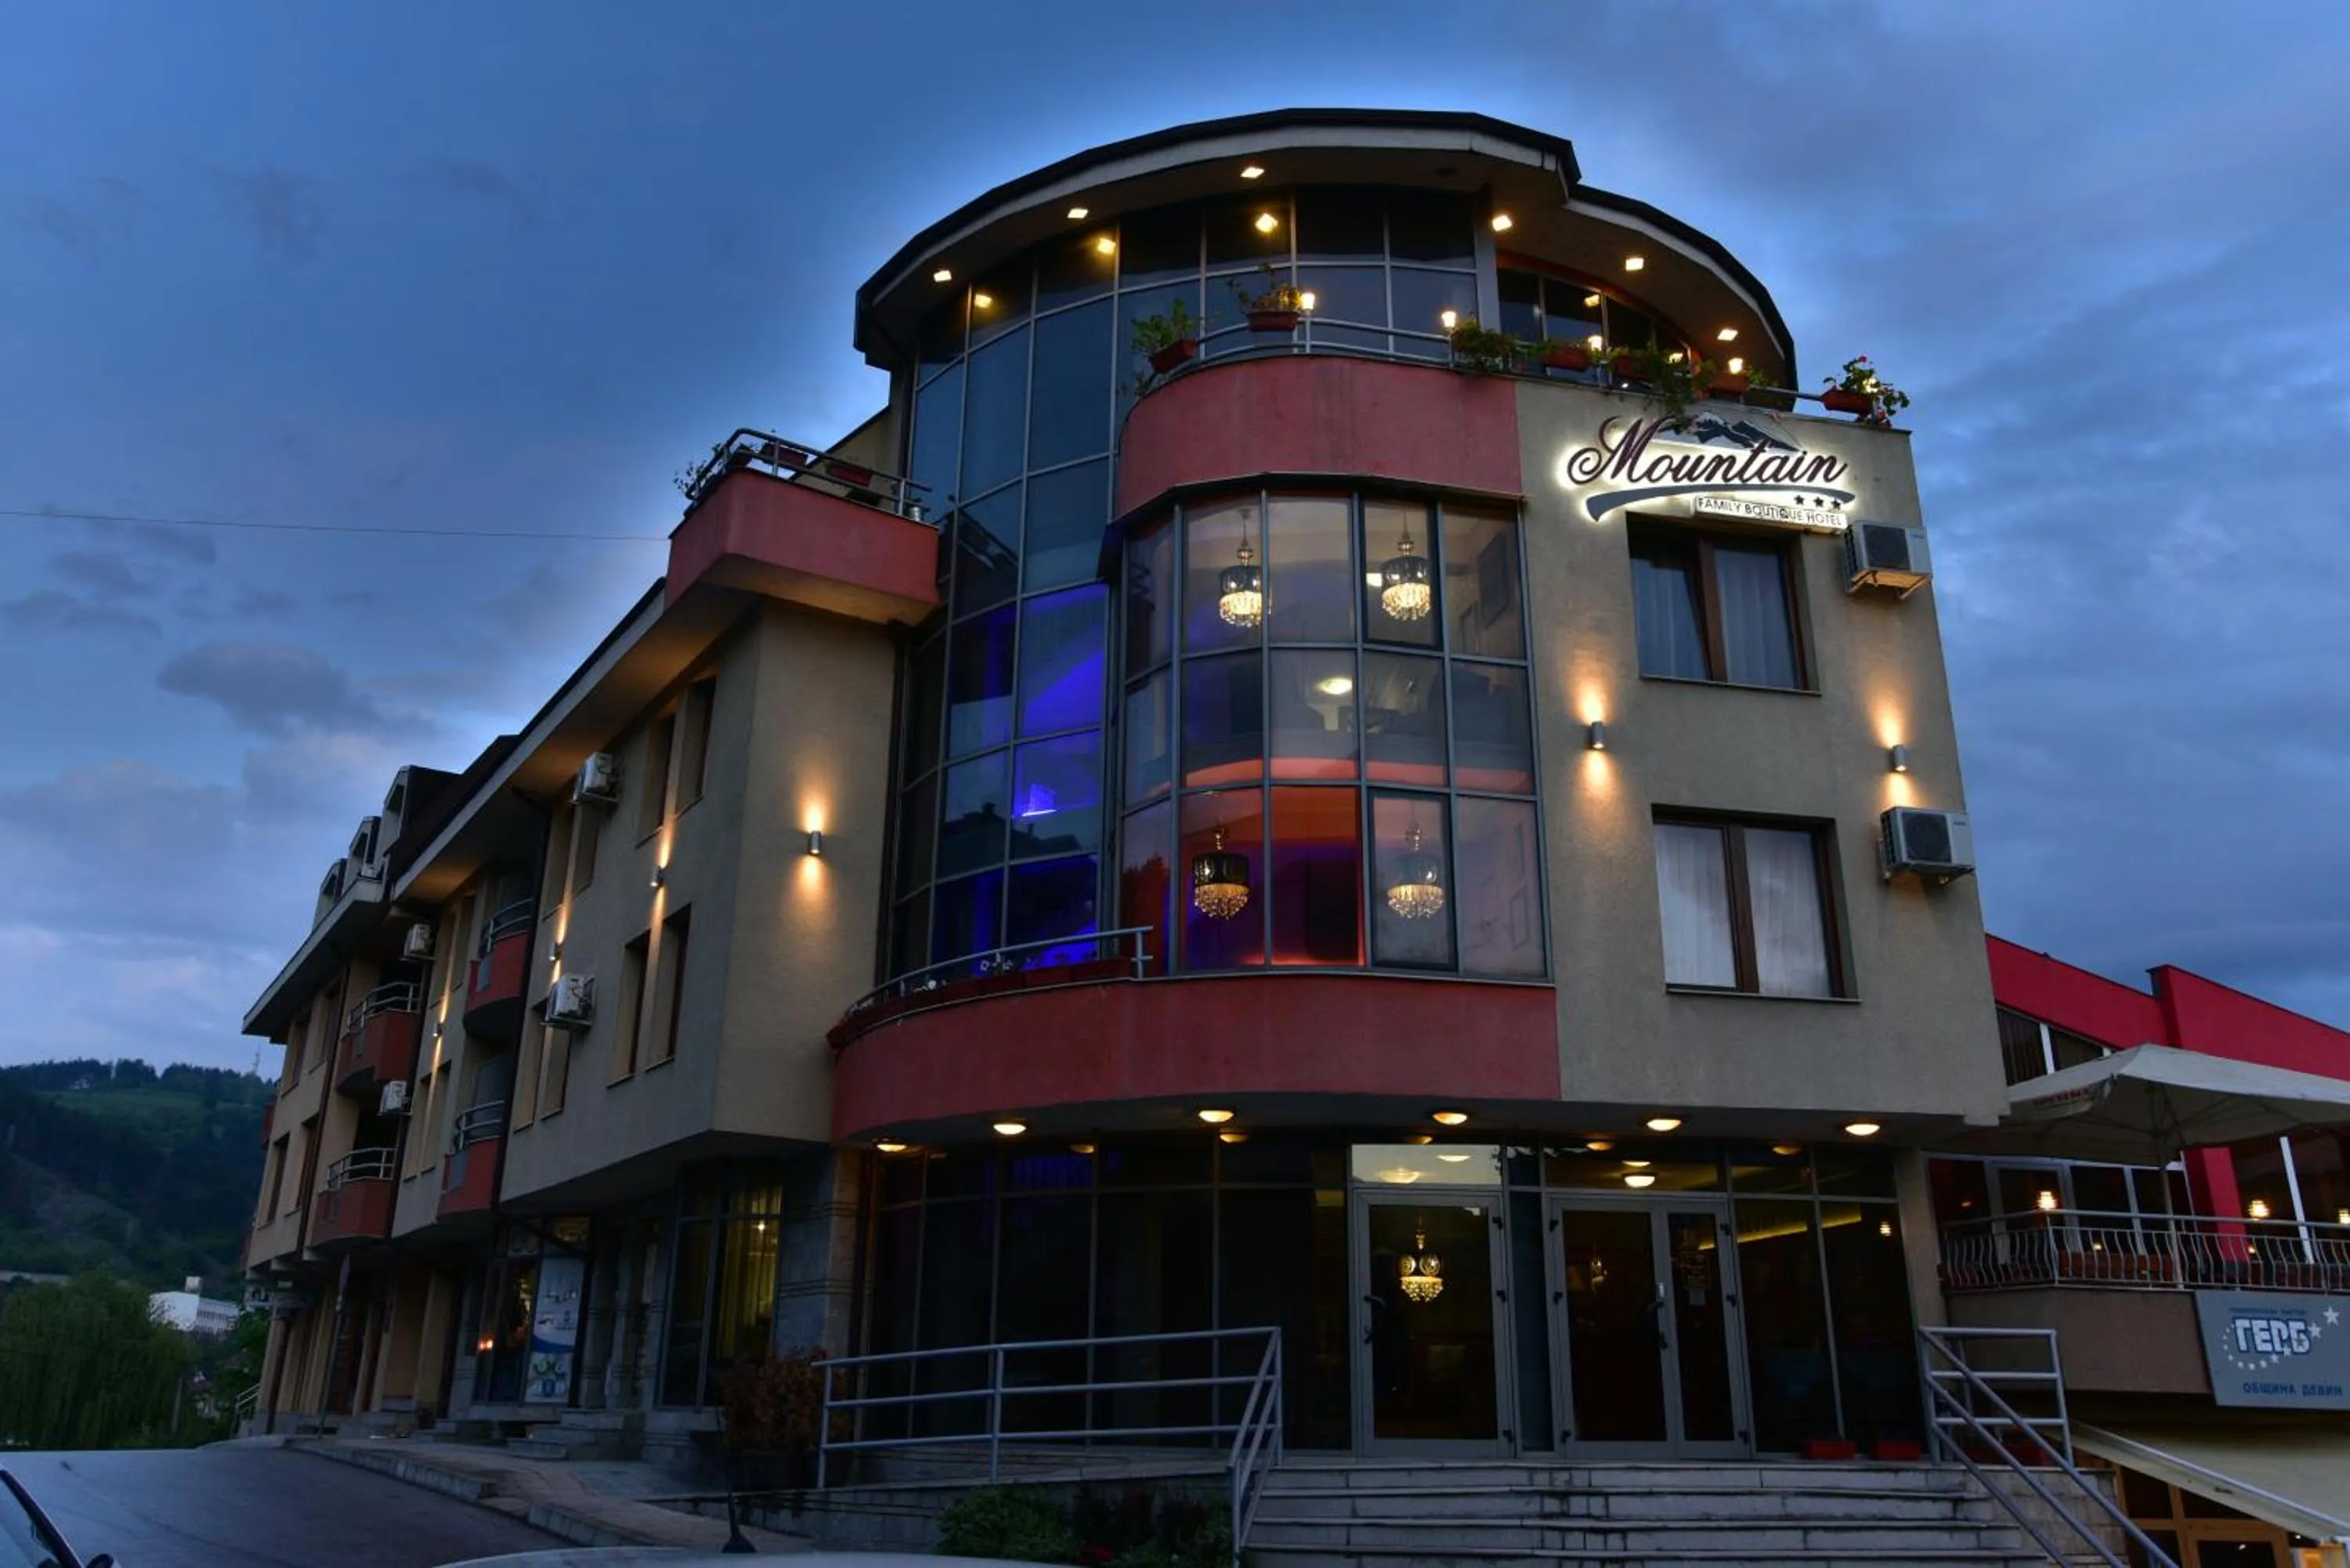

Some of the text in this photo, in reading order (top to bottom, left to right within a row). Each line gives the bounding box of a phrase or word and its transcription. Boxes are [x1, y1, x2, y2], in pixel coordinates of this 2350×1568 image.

[1567, 416, 1849, 486] Mountain
[1697, 497, 1842, 526] FAMILY BOUTIQUE HOTEL
[2232, 1317, 2311, 1355] ГЕРБ
[2243, 1382, 2297, 1396] ОБЩИНА
